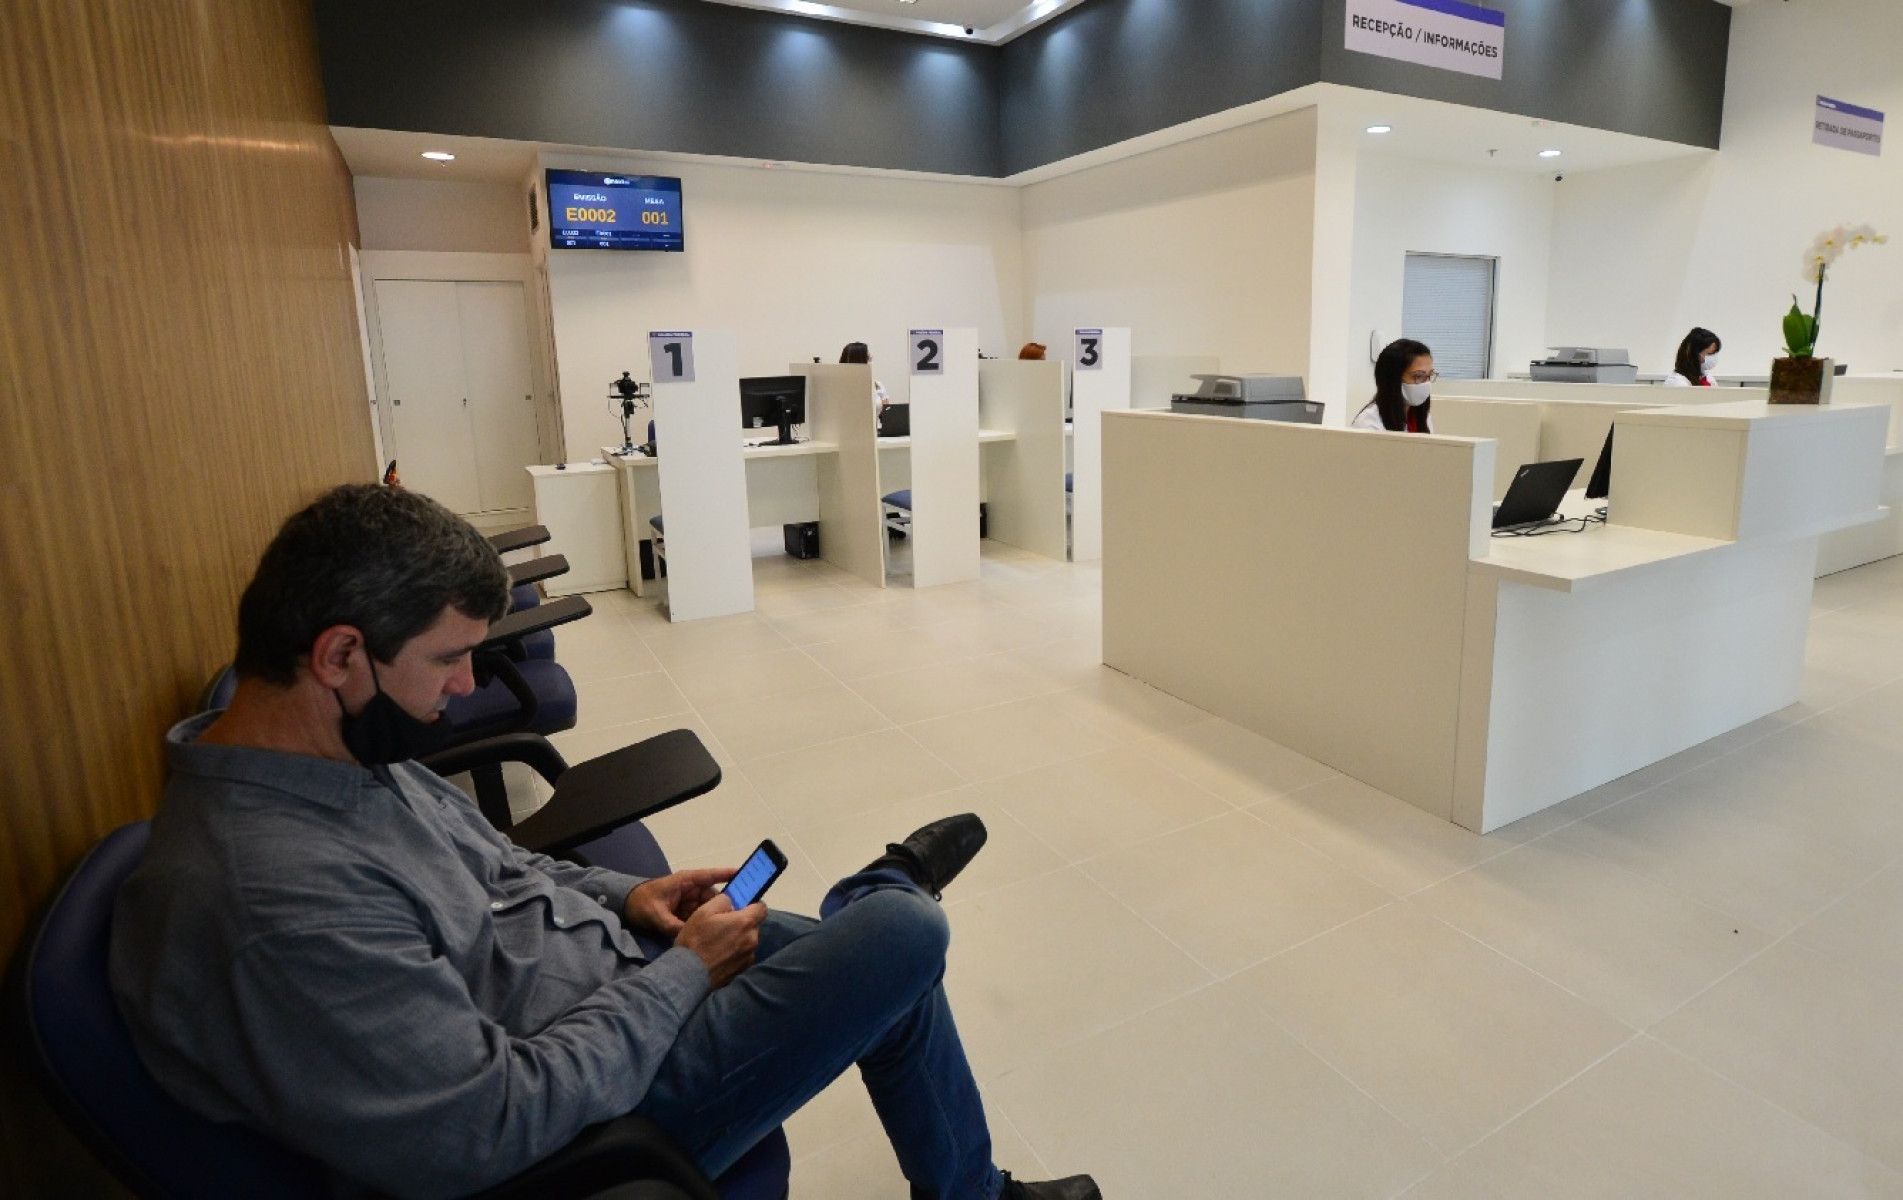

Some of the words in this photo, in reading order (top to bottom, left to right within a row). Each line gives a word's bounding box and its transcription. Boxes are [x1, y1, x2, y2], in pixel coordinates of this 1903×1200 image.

[1352, 13, 1413, 39] RECEPÇÃO
[1415, 28, 1422, 43] /
[1424, 31, 1498, 58] INFORMAÇÕES
[644, 197, 665, 205] MESA
[566, 207, 616, 223] E0002
[642, 211, 669, 225] 001
[664, 342, 683, 376] 1
[917, 339, 940, 370] 2
[1080, 338, 1098, 366] 3
